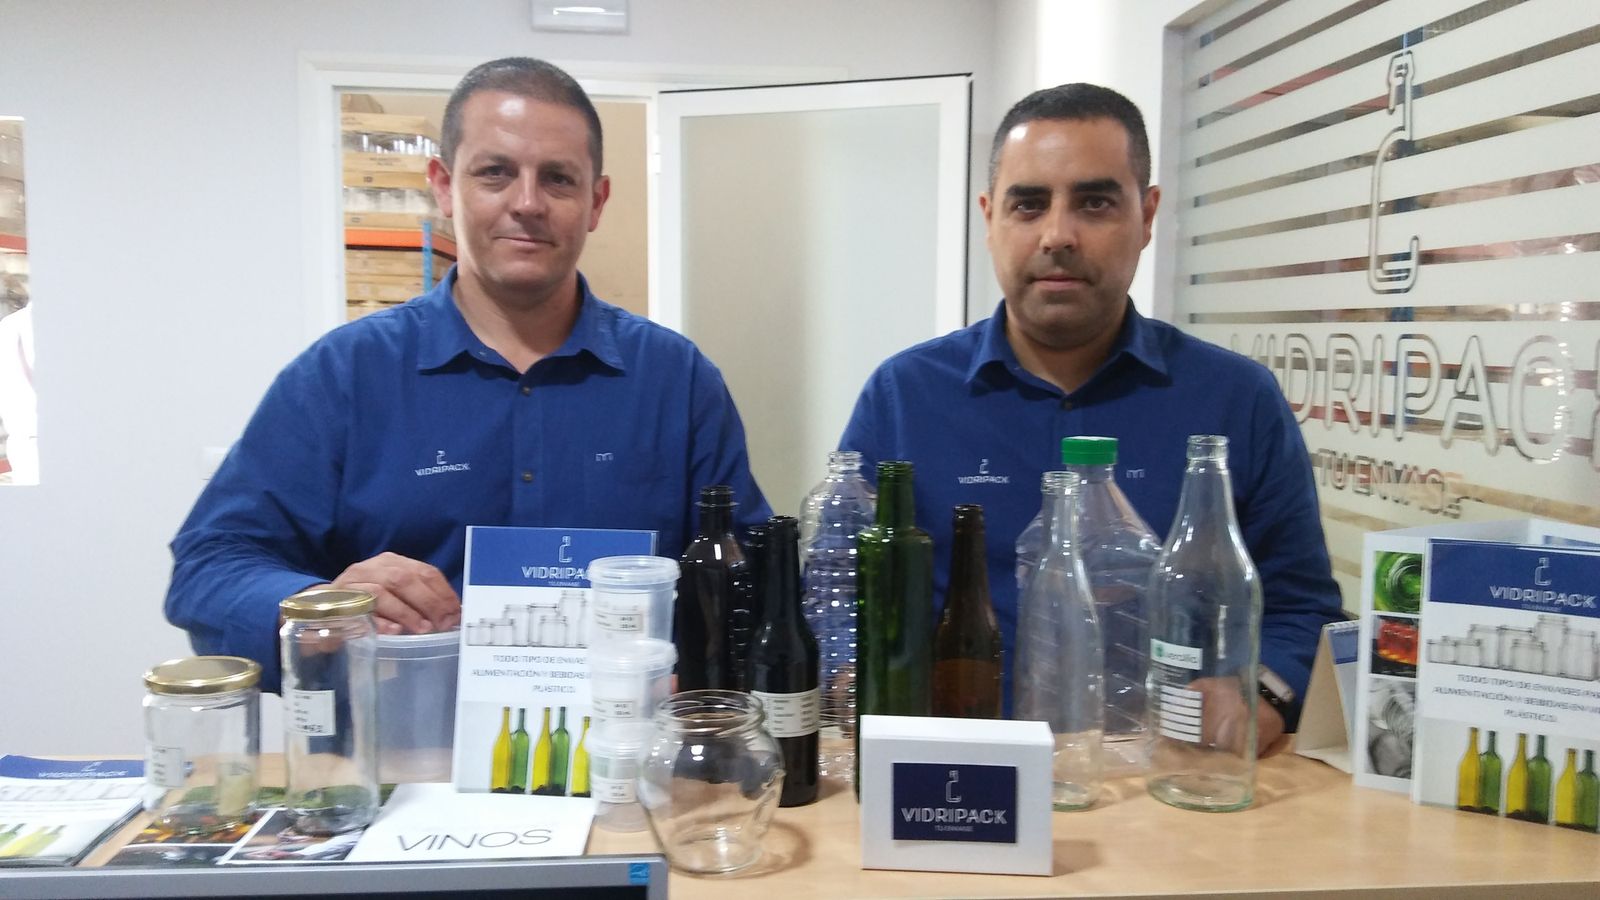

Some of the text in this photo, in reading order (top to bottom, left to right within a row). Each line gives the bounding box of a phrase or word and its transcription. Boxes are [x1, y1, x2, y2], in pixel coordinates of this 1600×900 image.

[1231, 333, 1600, 472] DRIPAC
[414, 463, 471, 477] VIDRIPACK
[521, 566, 588, 580] VIDRIPA
[1489, 585, 1598, 609] VIDRIPACK
[901, 806, 1008, 825] VIDRIPACK
[397, 828, 552, 851] VINOS
